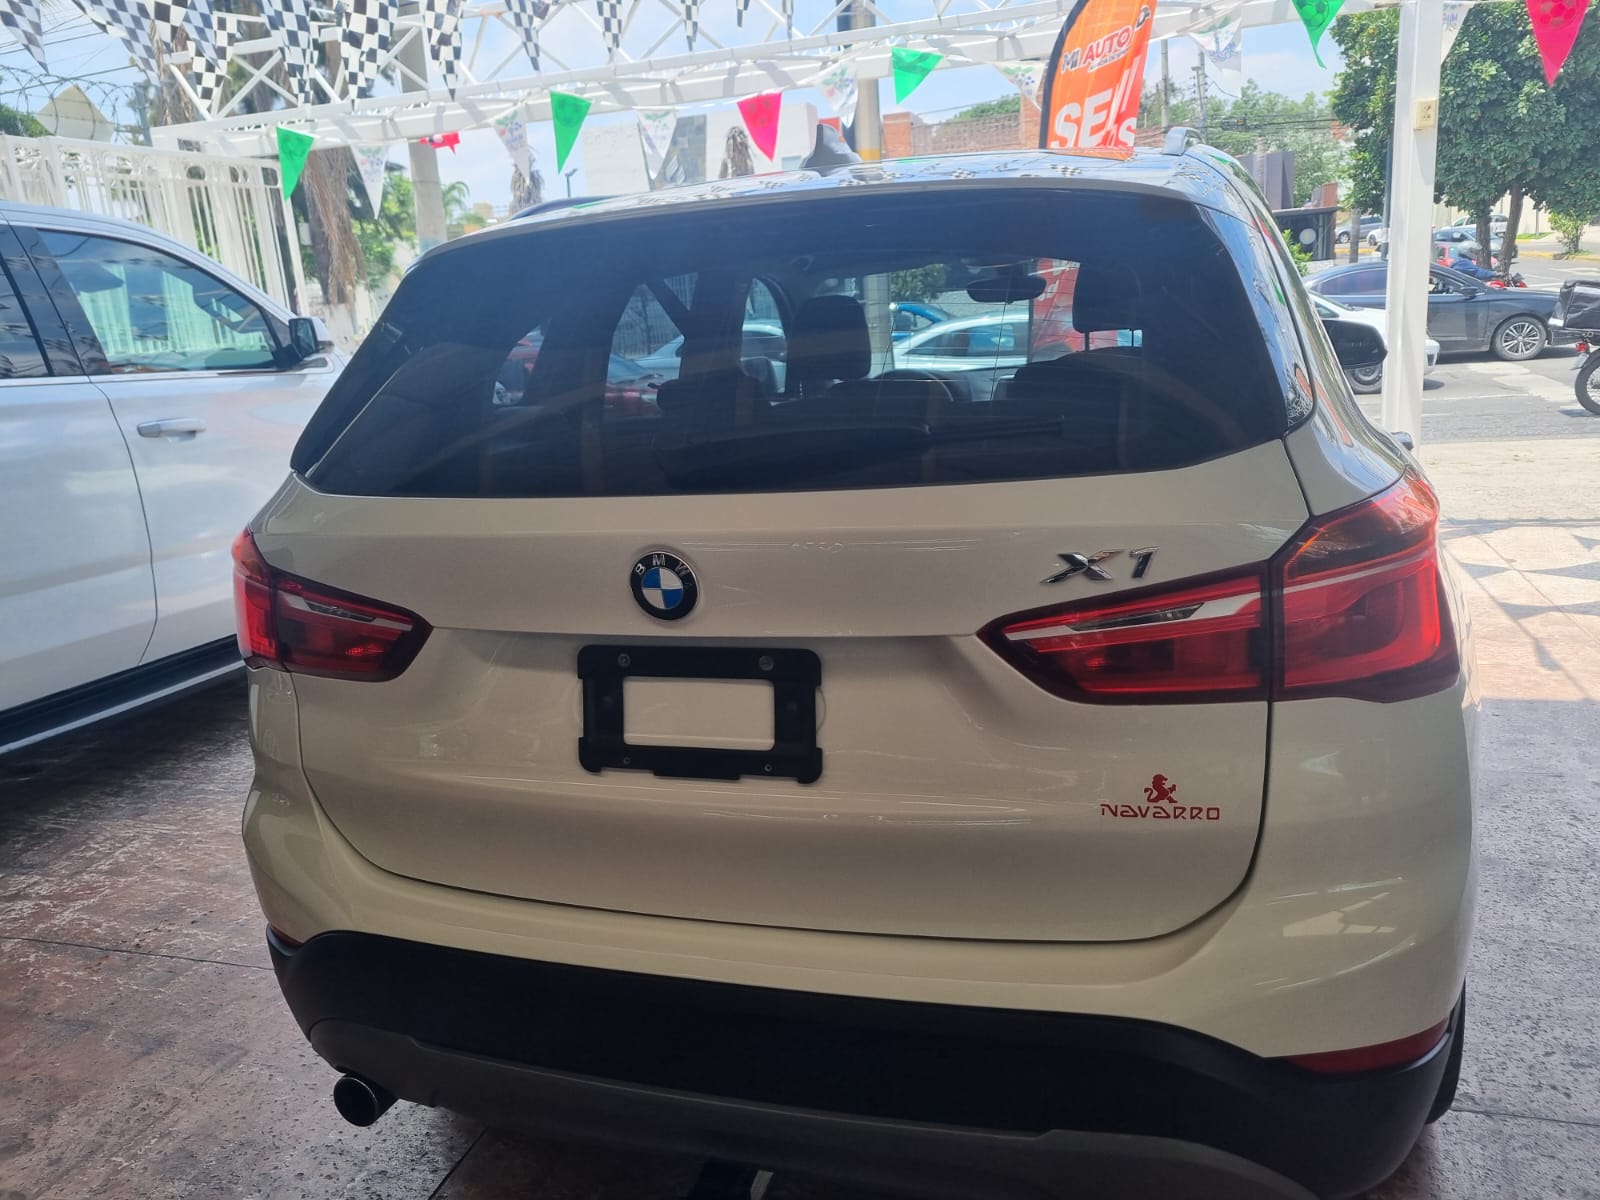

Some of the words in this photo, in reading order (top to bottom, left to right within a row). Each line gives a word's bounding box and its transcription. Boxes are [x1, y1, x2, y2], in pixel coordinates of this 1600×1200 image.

[1062, 48, 1081, 72] MI
[1083, 26, 1132, 65] AUTO
[635, 553, 690, 577] BMW
[1040, 545, 1160, 584] X1
[1100, 803, 1220, 820] NAVARRO
